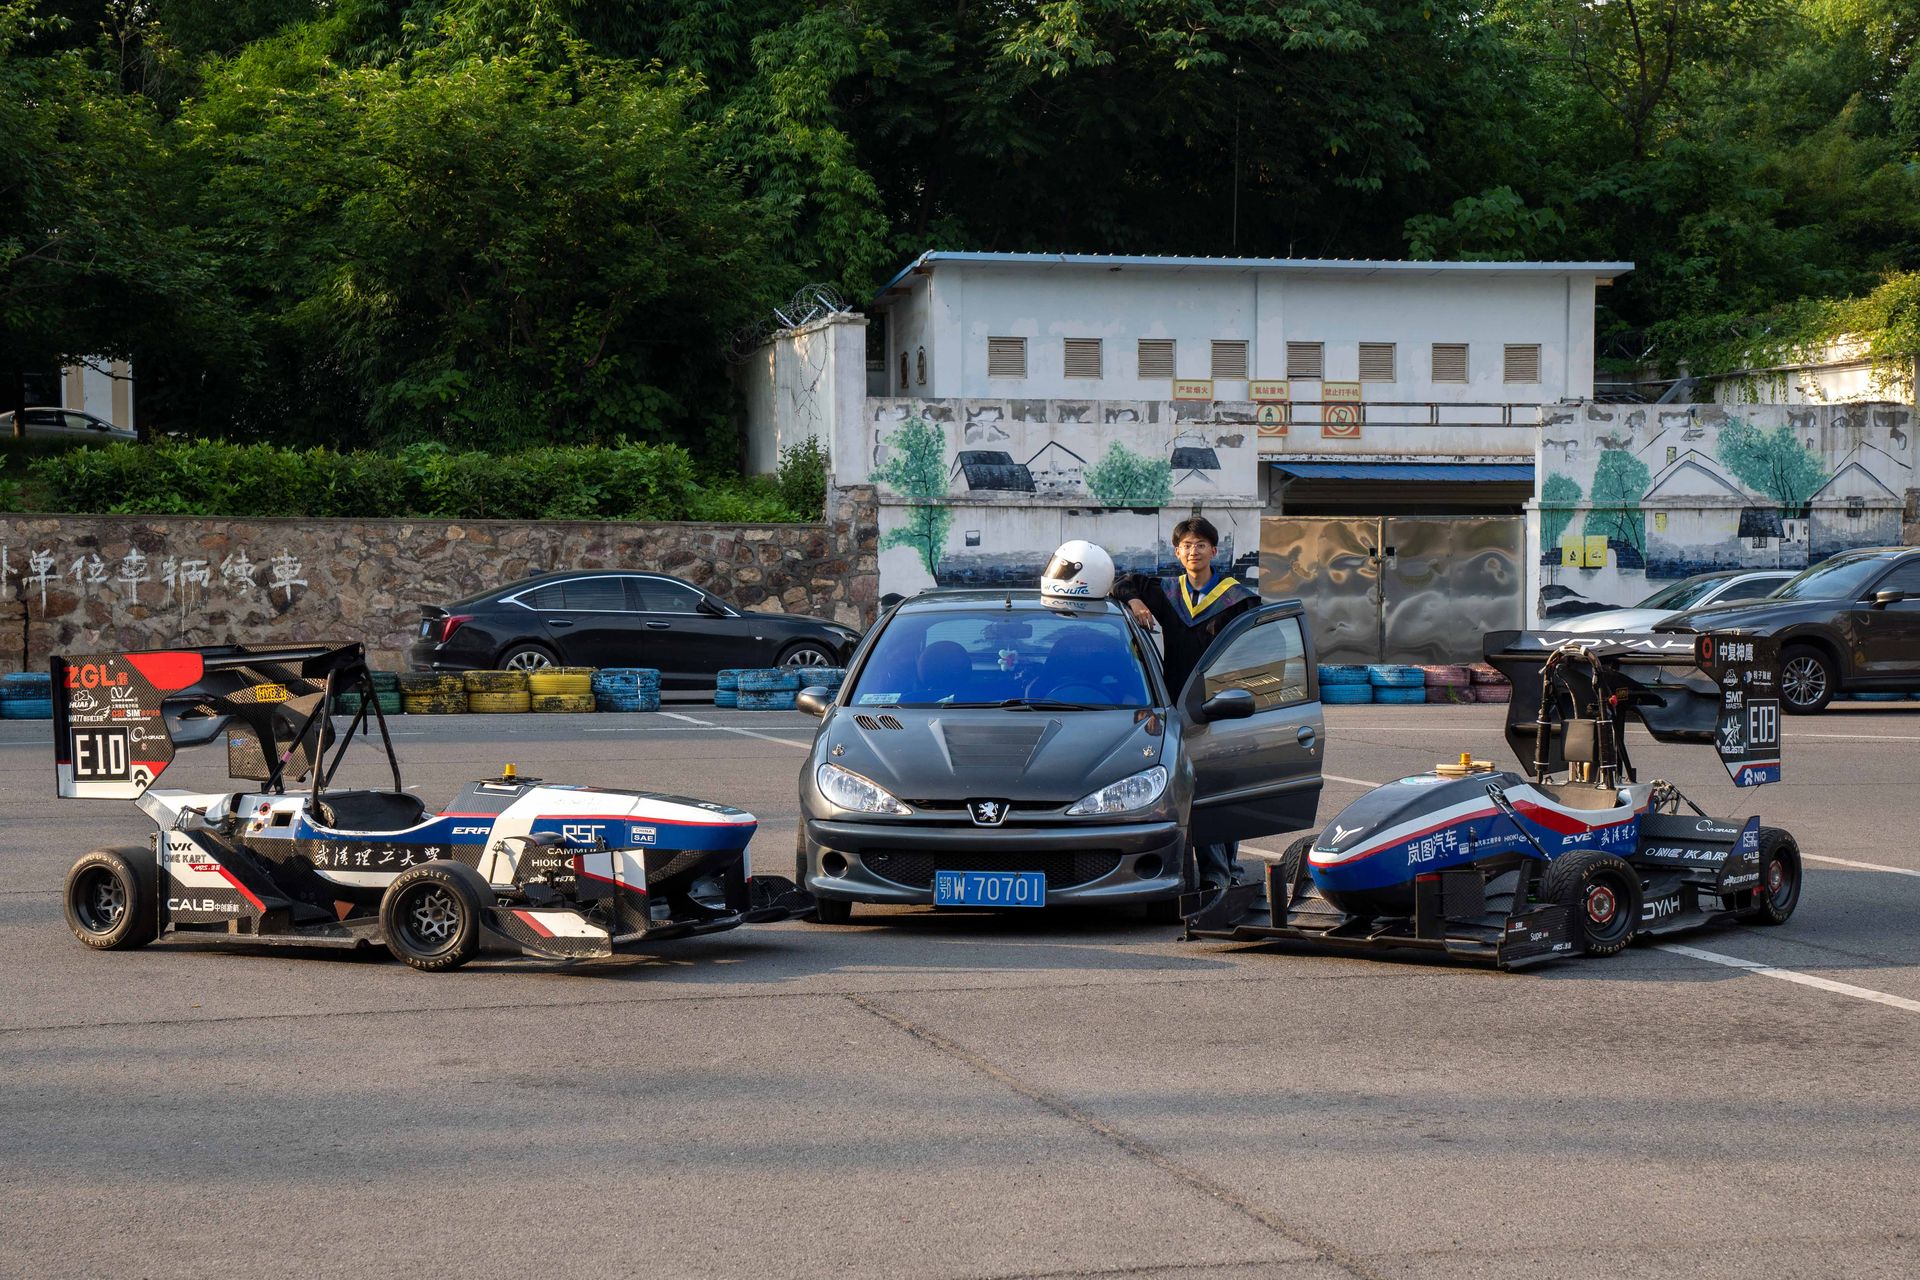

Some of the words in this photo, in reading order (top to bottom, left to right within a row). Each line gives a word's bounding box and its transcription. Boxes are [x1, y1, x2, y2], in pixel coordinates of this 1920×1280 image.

[1725, 690, 1743, 702] SMT
[1753, 770, 1767, 782] NIO
[633, 834, 654, 842] SAE
[1561, 831, 1593, 845] EVE
[1407, 829, 1458, 866] 岚图汽车
[182, 854, 207, 864] KART
[1683, 849, 1728, 861] KAR
[1743, 851, 1760, 861] CALB
[531, 859, 562, 867] HIOKI
[167, 898, 215, 912] CALB
